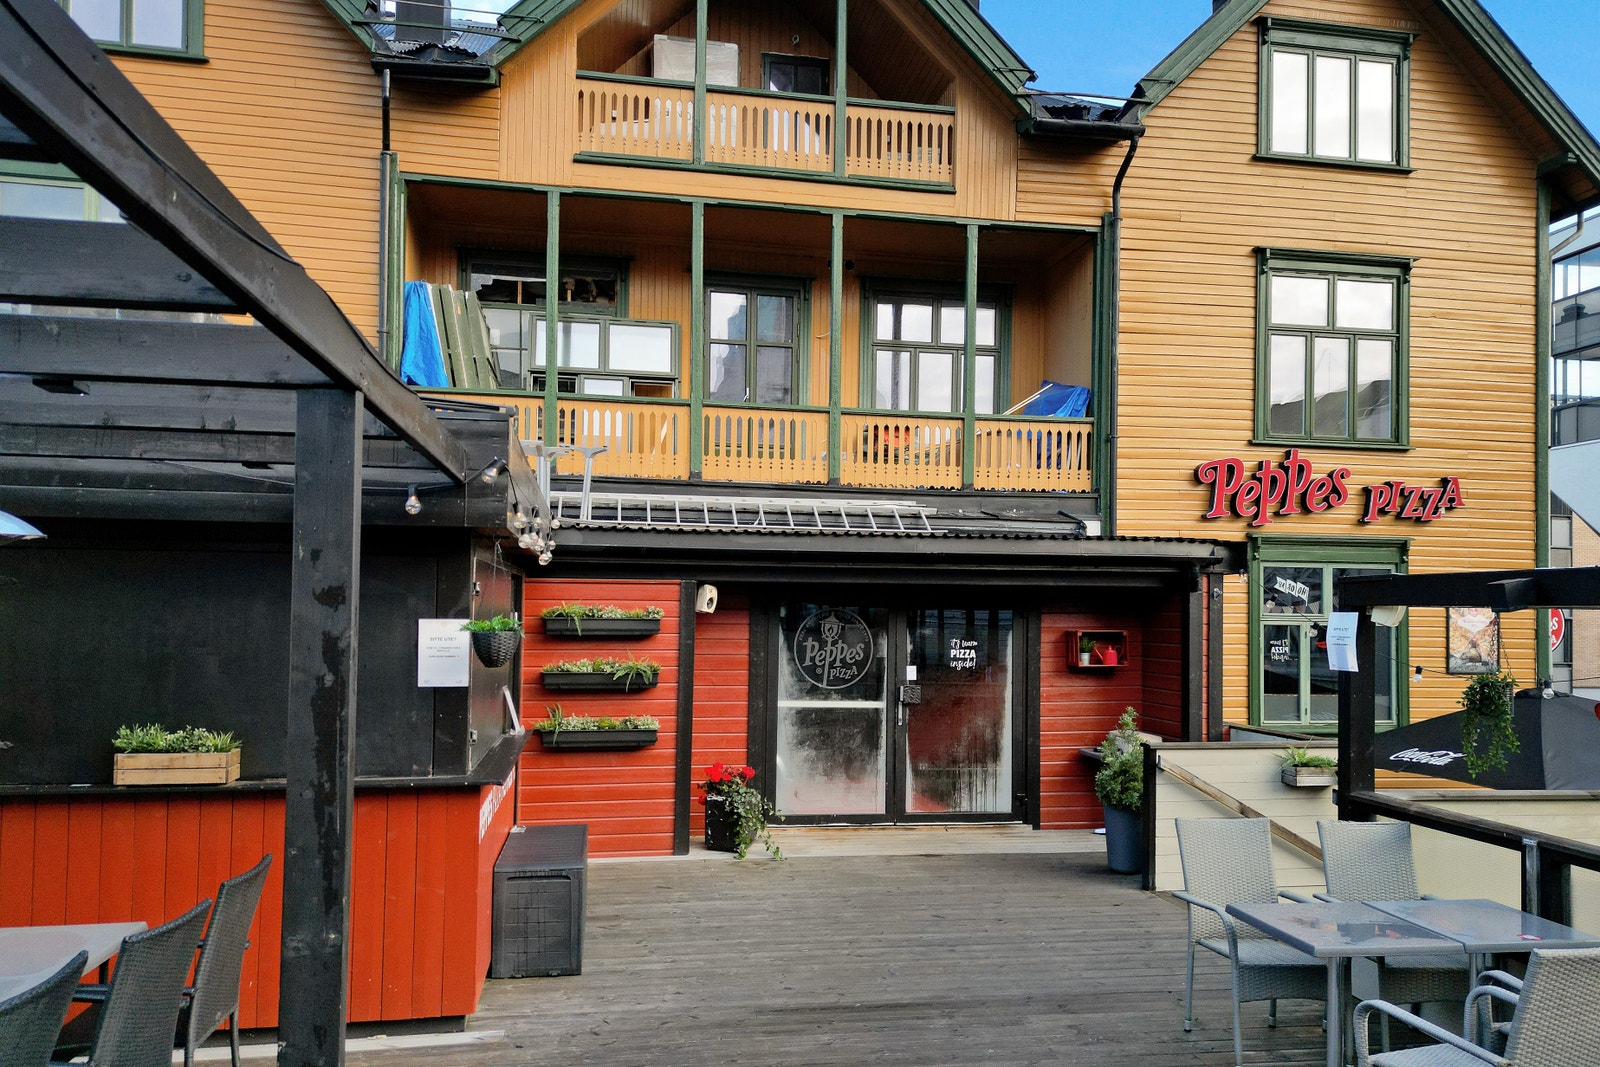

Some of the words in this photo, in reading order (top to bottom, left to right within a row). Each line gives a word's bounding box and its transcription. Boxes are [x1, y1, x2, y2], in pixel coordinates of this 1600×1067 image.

[1195, 447, 1351, 527] Peppes
[1361, 475, 1466, 523] PIZZA
[801, 636, 865, 667] Peppes
[950, 649, 976, 658] PIZZA
[950, 657, 976, 671] inside!
[829, 665, 858, 680] PIZZA
